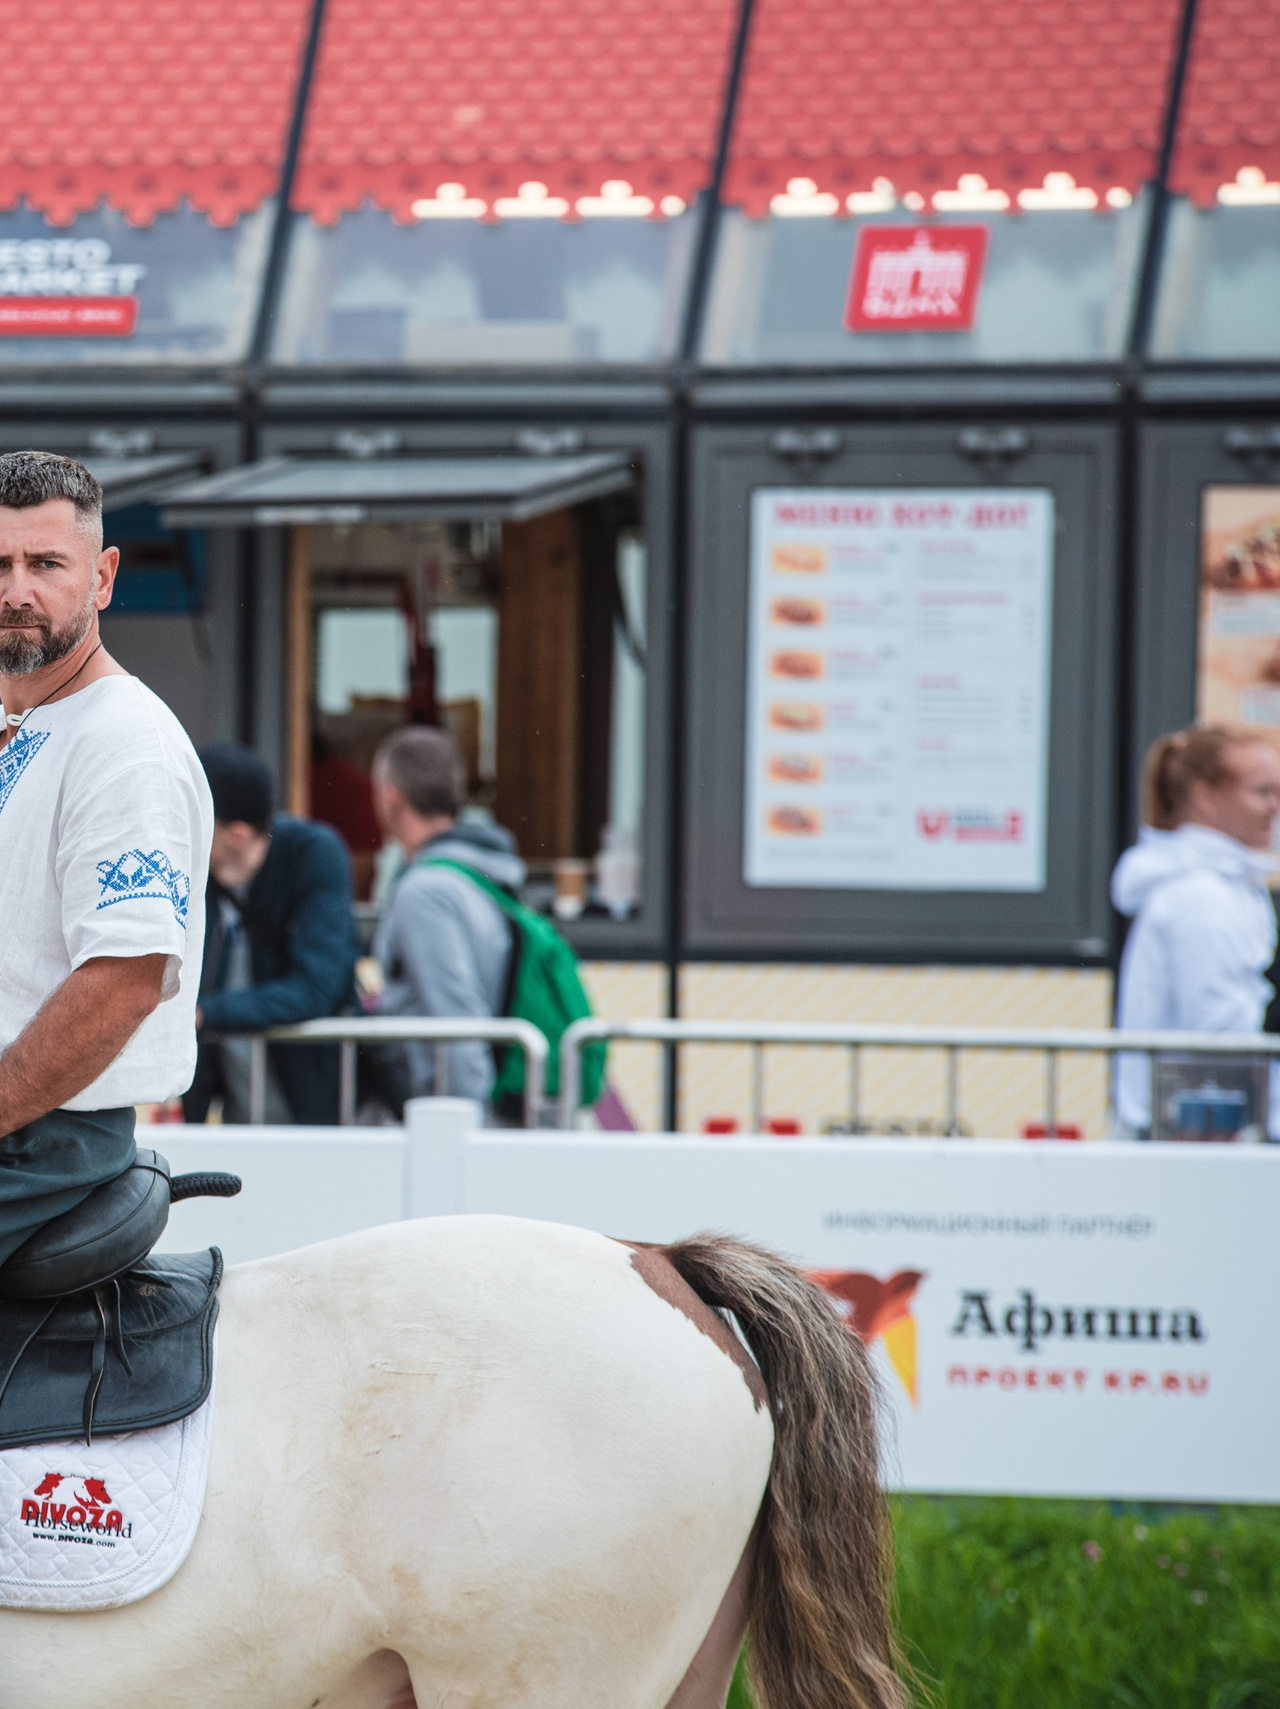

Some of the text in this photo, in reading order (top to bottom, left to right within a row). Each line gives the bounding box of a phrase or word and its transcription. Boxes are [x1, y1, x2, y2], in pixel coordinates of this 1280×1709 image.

[951, 1288, 1207, 1353] Афиша
[948, 1362, 1086, 1390] ПРОЕКТ
[20, 1499, 123, 1531] DIVOZA
[24, 1510, 132, 1539] Horseworld
